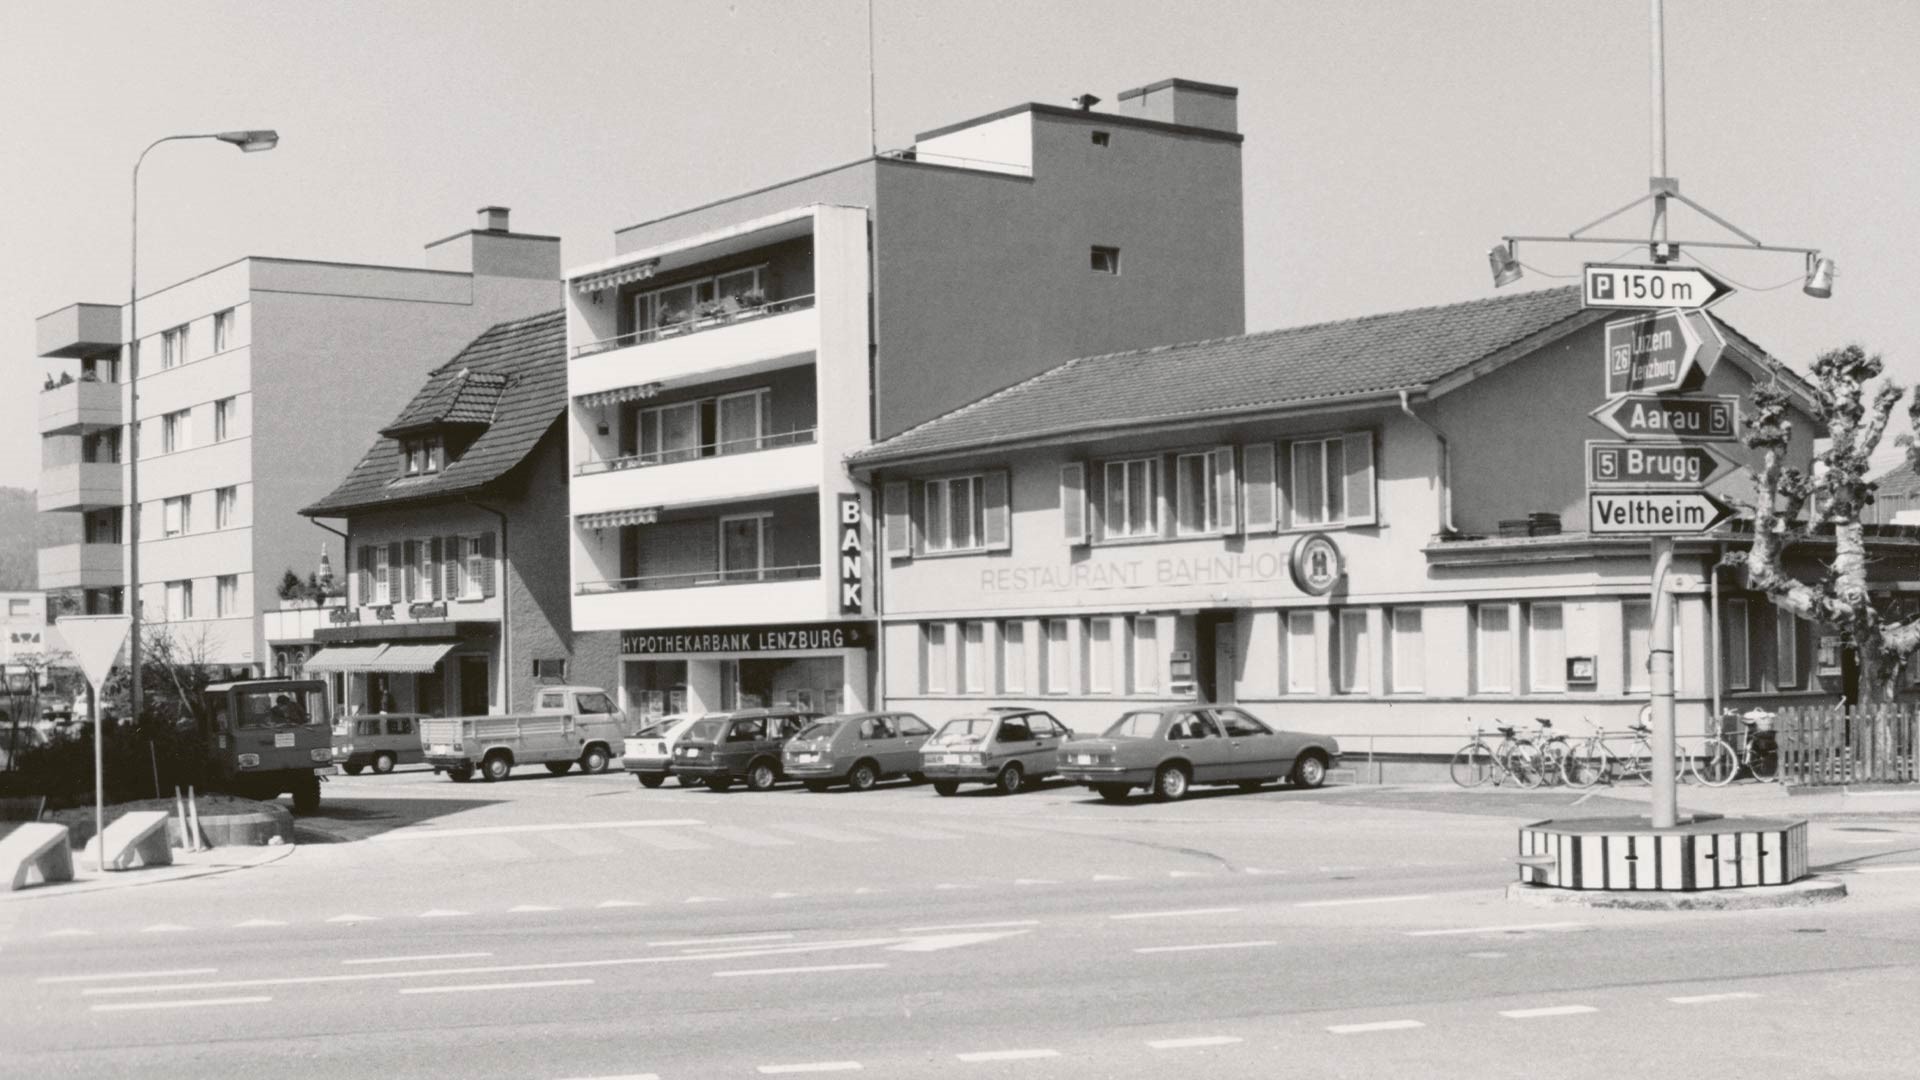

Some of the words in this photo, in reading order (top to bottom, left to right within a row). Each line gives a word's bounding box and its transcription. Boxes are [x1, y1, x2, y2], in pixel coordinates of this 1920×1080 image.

[1597, 276, 1610, 298] P
[1623, 275, 1665, 299] 150
[1672, 282, 1692, 300] m
[1631, 330, 1672, 354] Luzern
[1615, 349, 1628, 371] 26
[1632, 358, 1676, 381] Lenzburg
[1630, 403, 1700, 429] Aarau
[1713, 409, 1725, 429] 5
[1601, 454, 1614, 475] 5
[1627, 449, 1700, 481] Brugg
[1597, 500, 1705, 525] Veltheim
[841, 500, 862, 606] BANK
[981, 560, 1142, 591] RESTAURANT
[622, 633, 750, 653] HYPOTHEKARBANK
[759, 628, 844, 650] LENZBURG
